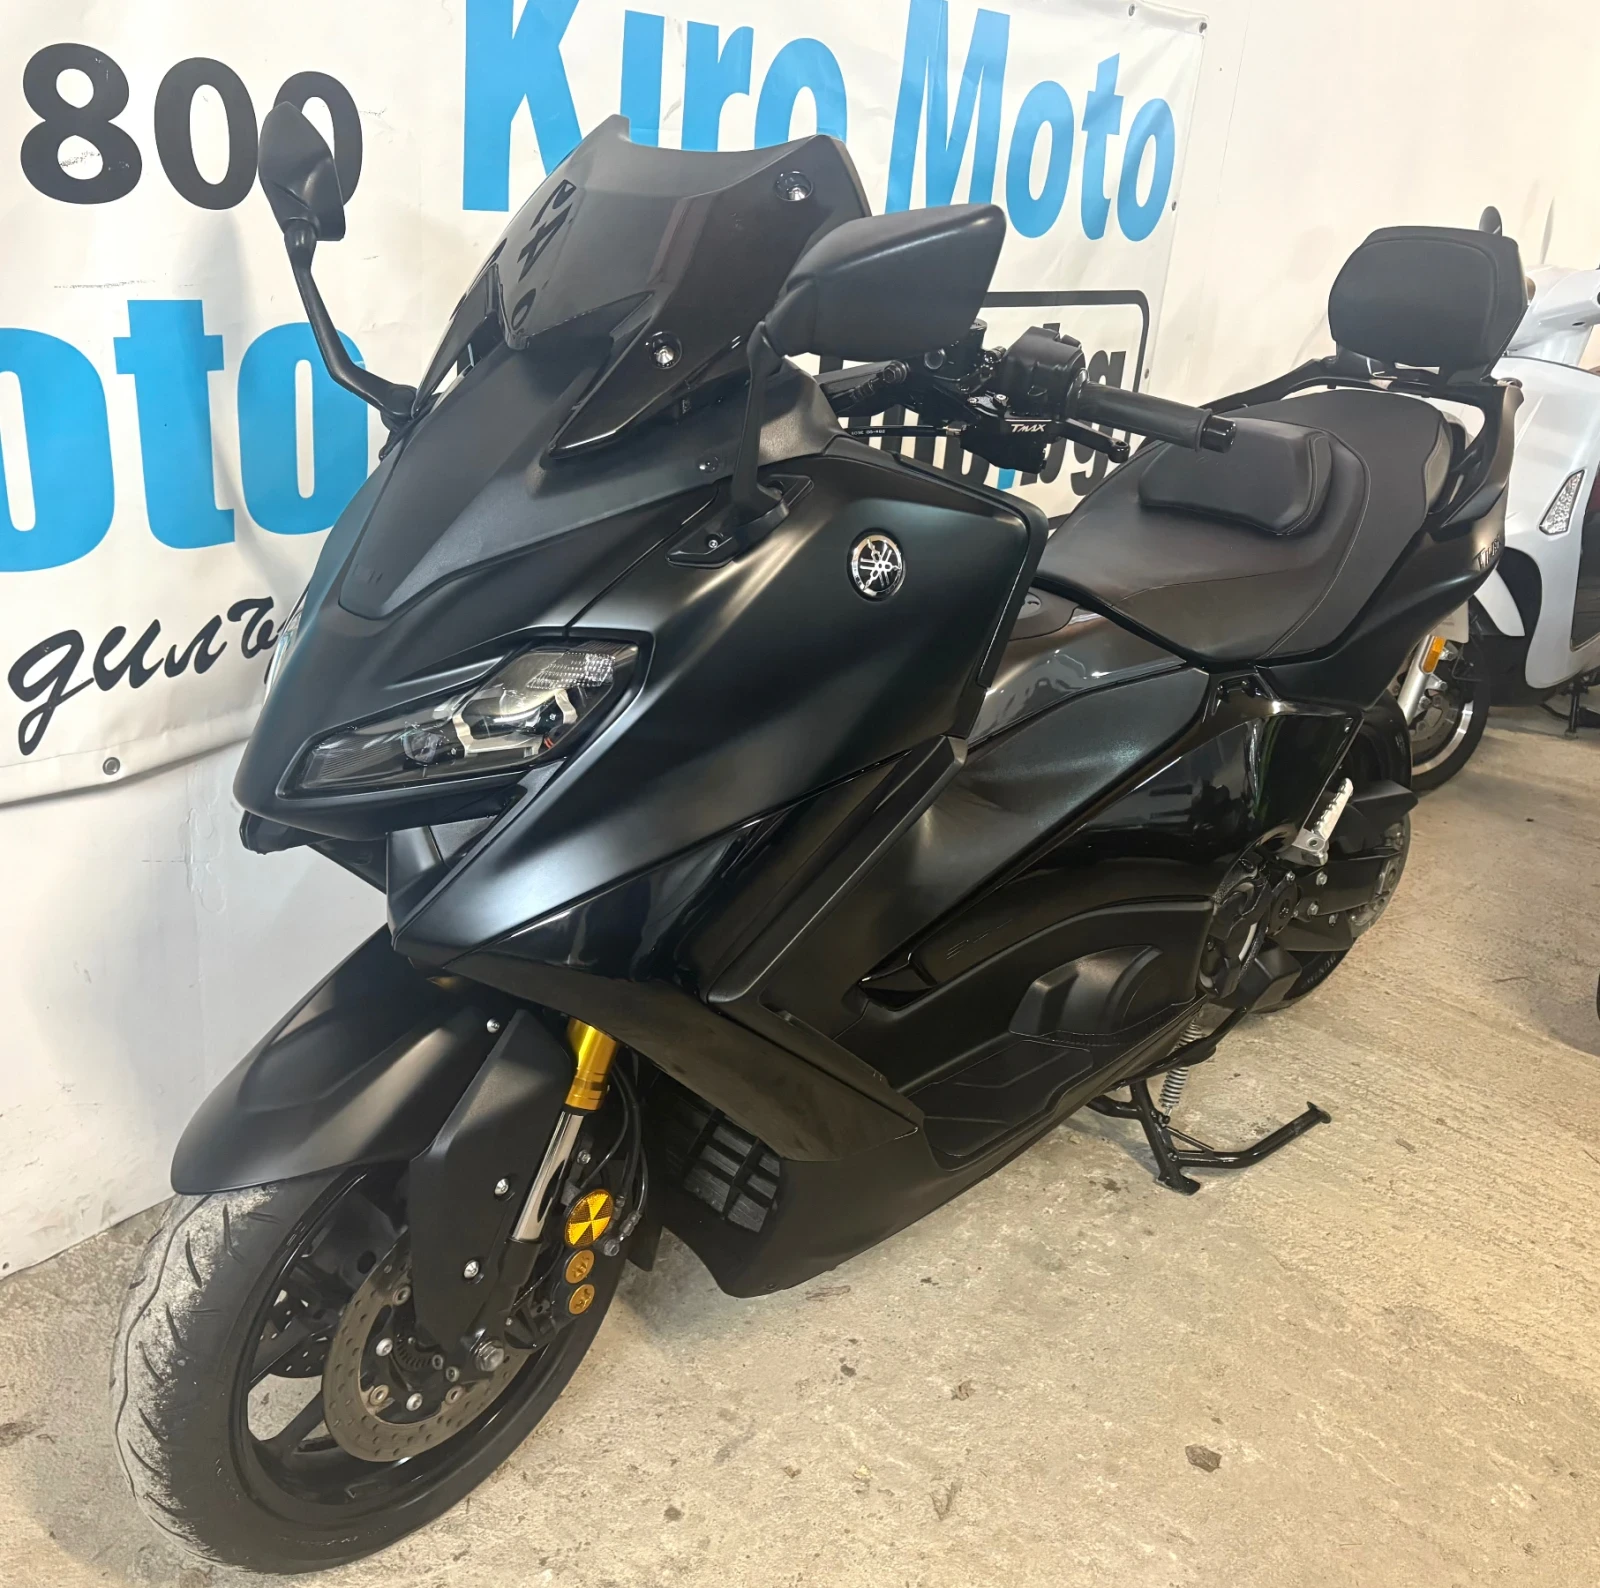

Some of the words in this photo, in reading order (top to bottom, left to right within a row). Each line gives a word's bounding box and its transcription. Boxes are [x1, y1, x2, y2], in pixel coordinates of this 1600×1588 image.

[884, 0, 1176, 242] Moto
[1011, 423, 1046, 433] TMAX
[7, 596, 284, 756] дилъ
